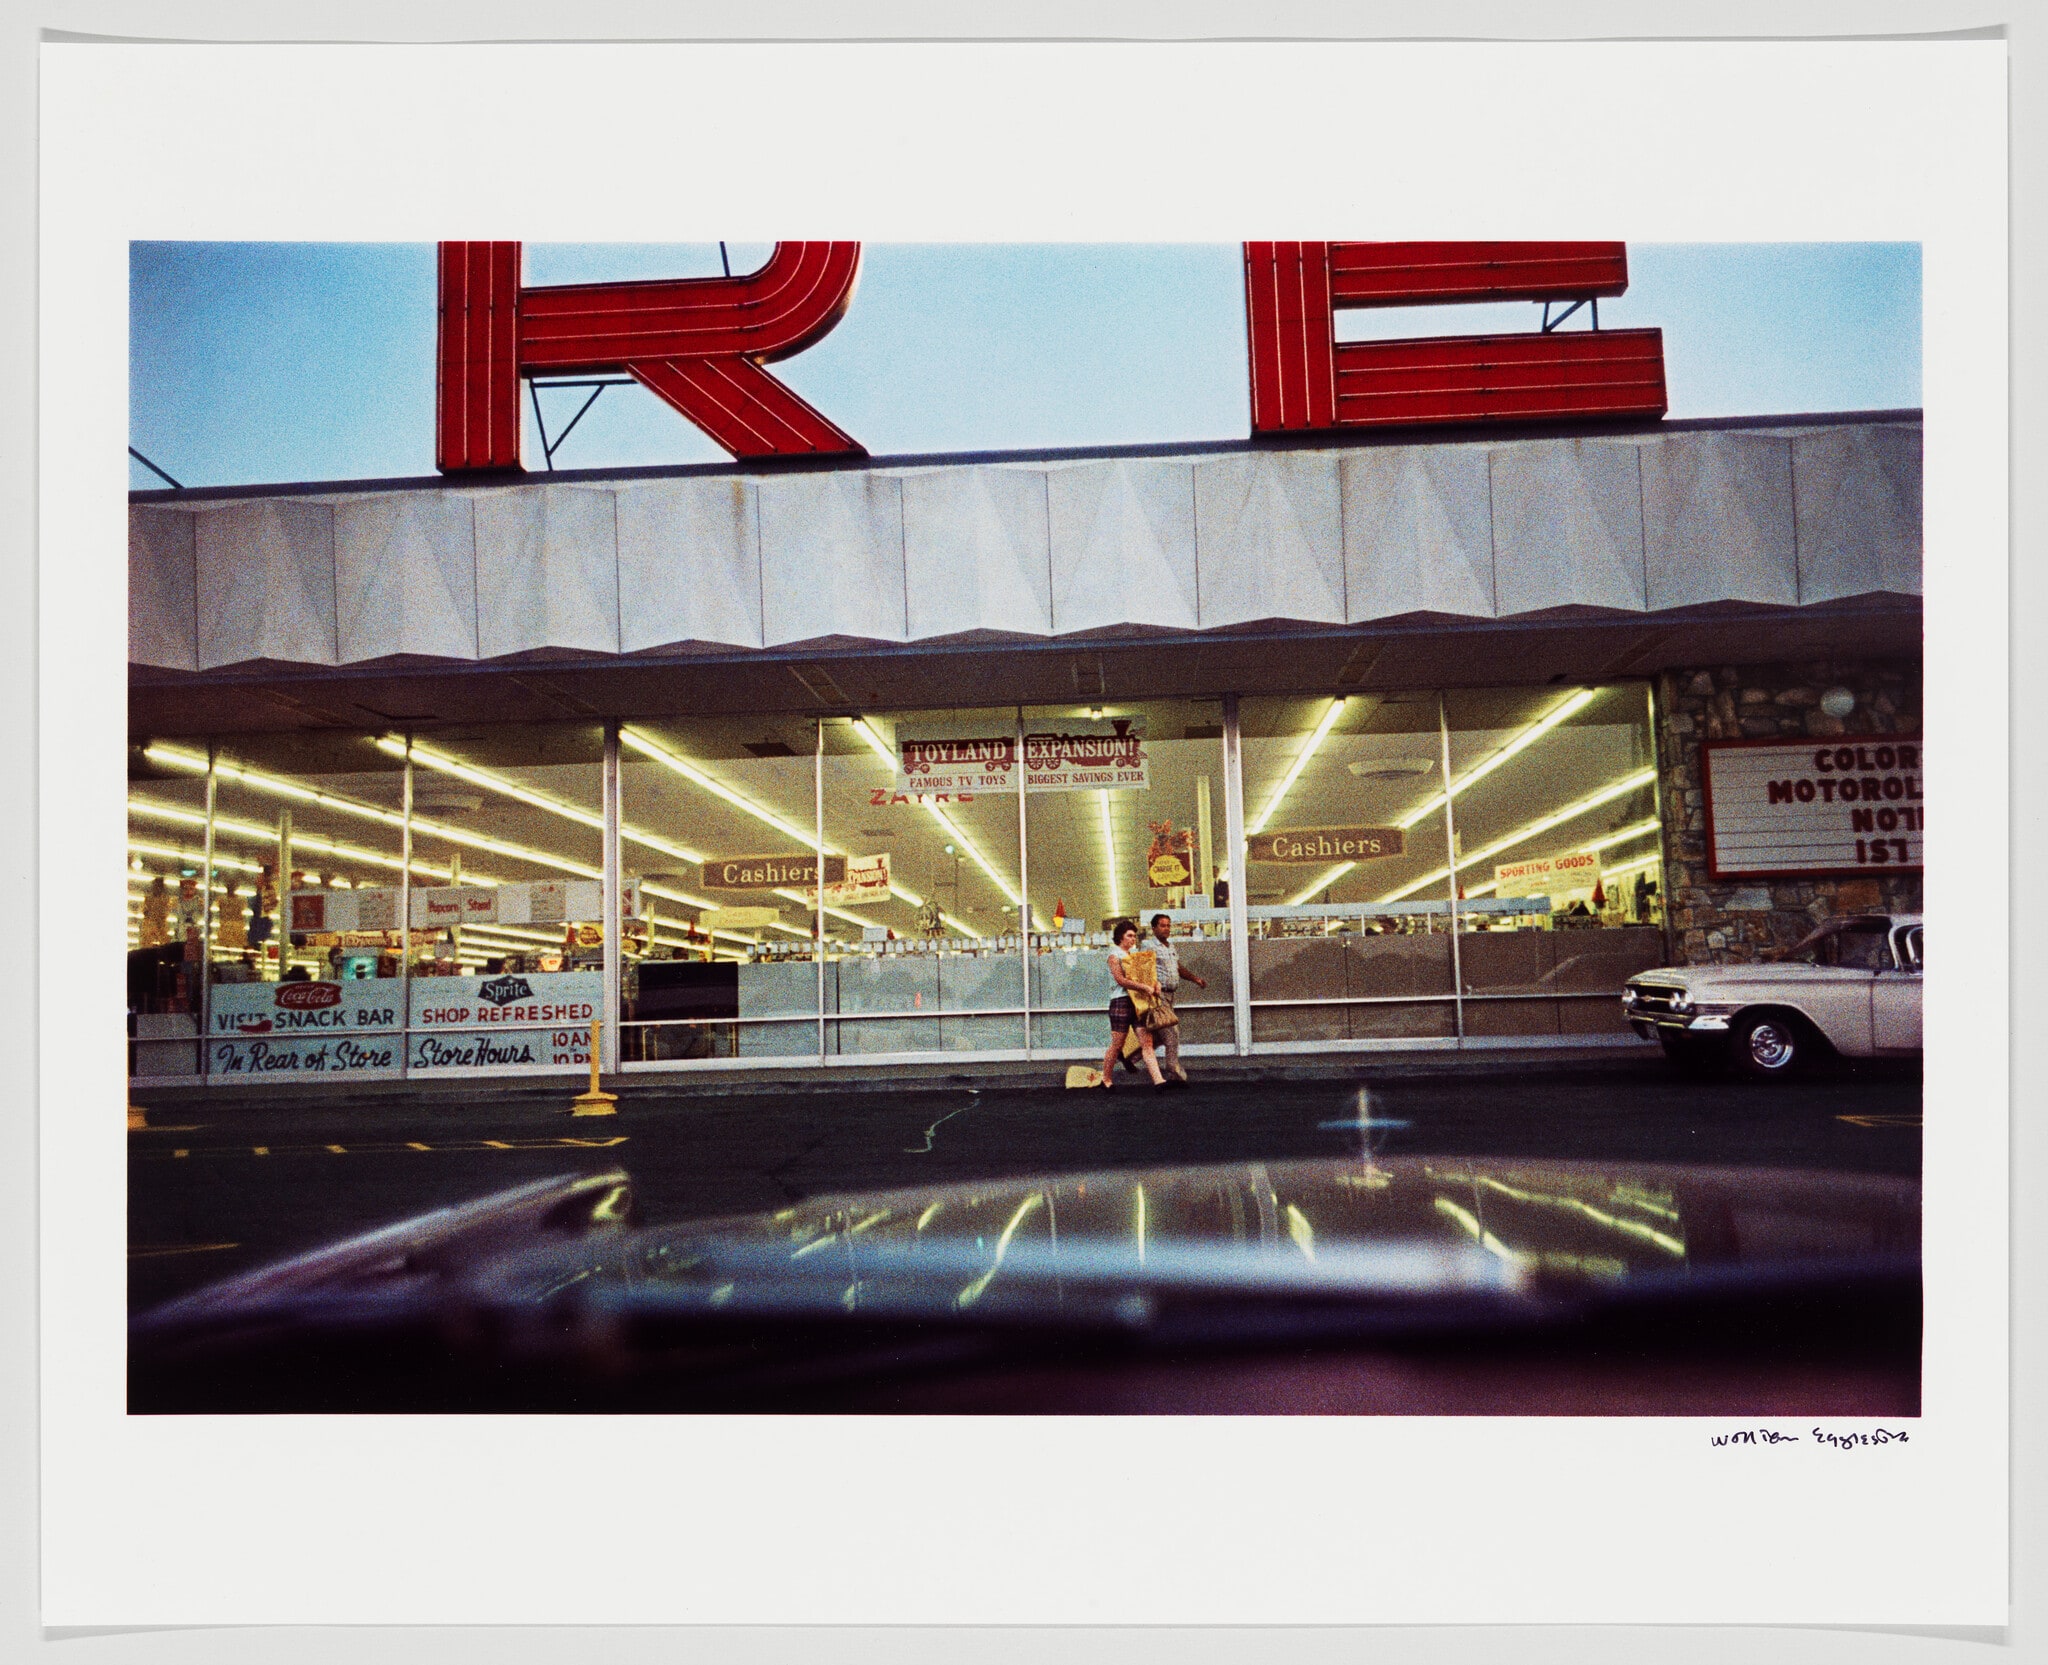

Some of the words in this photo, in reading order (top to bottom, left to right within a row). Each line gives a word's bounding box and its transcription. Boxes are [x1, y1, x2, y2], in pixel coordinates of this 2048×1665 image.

[909, 742, 1007, 763] TOYLAND
[1026, 738, 1135, 760] EXPANSION!
[1814, 745, 1919, 773] COLOR
[909, 777, 953, 788] FAMOUS
[957, 776, 973, 786] TV
[980, 775, 1007, 786] TOYS
[1027, 773, 1068, 785] BIGGEST
[1072, 772, 1114, 784] SAVINGS
[1117, 771, 1145, 783] EVER
[1767, 776, 1923, 805] MOTOROL
[1272, 836, 1382, 858] Cashiers
[1500, 863, 1550, 879] SPORTING
[1555, 854, 1594, 870] GOODS
[484, 982, 529, 1001] Sprite
[275, 1010, 347, 1029] SNACK
[357, 1008, 395, 1026] BAR
[422, 1008, 470, 1024] SHOP
[477, 1003, 593, 1022] REFRESHED
[552, 1032, 569, 1047] 10
[249, 1042, 300, 1073] Rear
[331, 1040, 393, 1071] Store
[413, 1038, 474, 1069] Store
[473, 1037, 536, 1067] Hours
